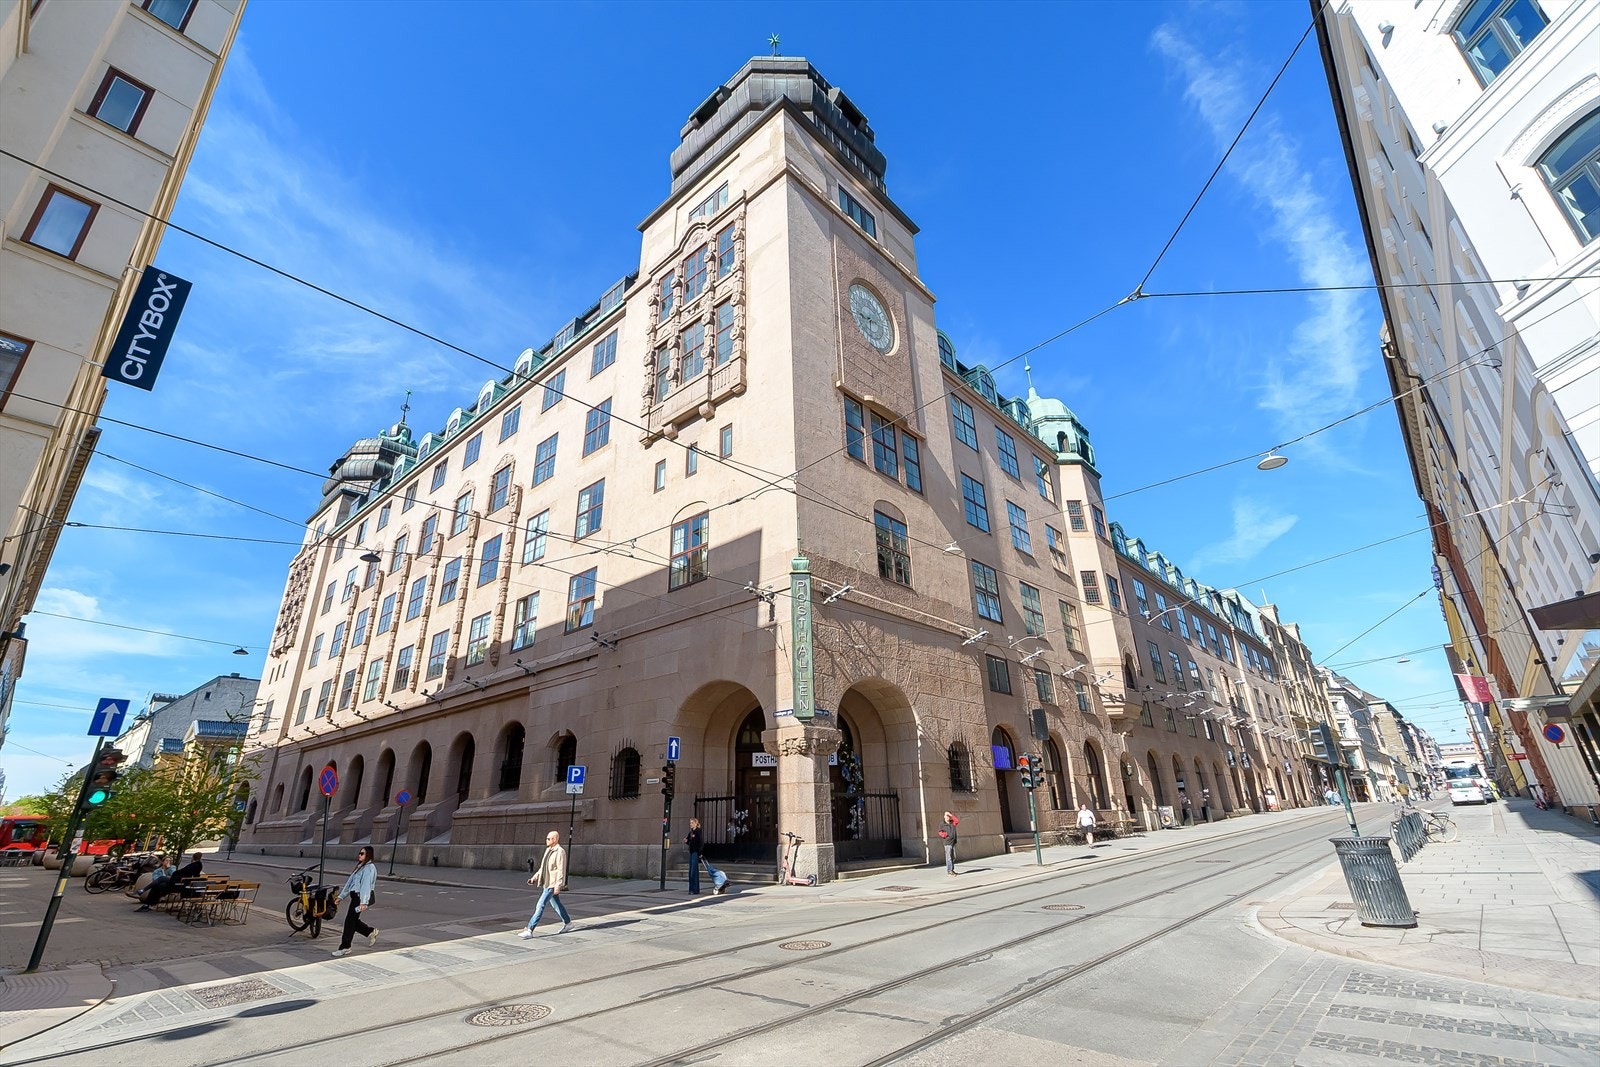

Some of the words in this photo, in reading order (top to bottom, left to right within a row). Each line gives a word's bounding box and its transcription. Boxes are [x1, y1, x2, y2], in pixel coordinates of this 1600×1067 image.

[120, 276, 177, 380] CITYBOX
[796, 580, 809, 710] POSTHALLEN
[571, 768, 581, 782] P
